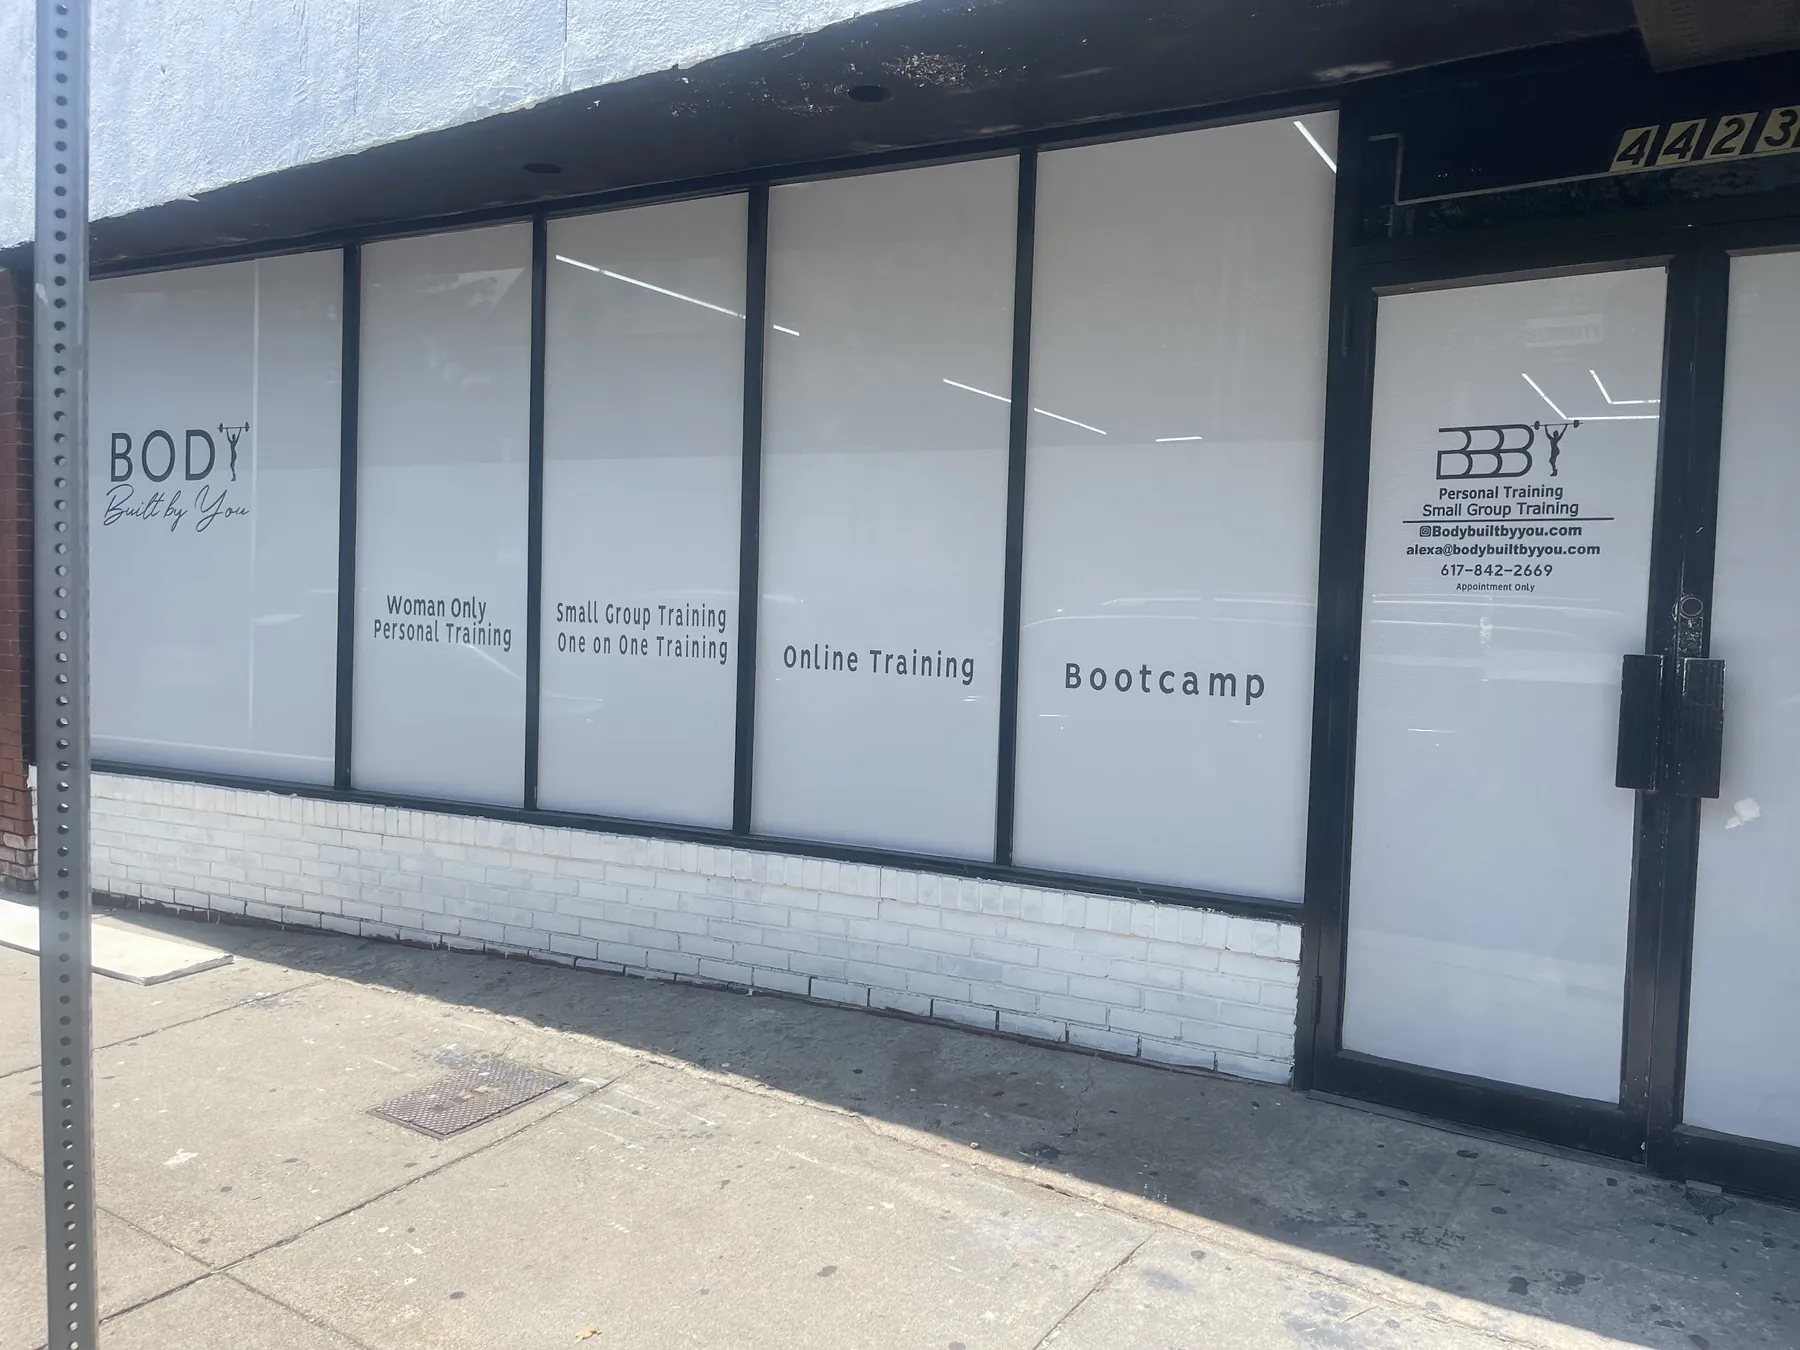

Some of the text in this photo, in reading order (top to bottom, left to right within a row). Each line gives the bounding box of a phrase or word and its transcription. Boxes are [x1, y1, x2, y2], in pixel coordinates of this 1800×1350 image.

[1616, 109, 1799, 166] 4423
[103, 483, 250, 533] Built by You
[1439, 484, 1564, 501] Personal Training
[1422, 501, 1579, 518] Small Group Training
[1432, 524, 1583, 540] Bodybuiltbyyou.com
[1406, 543, 1601, 558] alexa@bodybuiltbyyou.com
[1440, 563, 1553, 577] 617-842-2669
[1455, 582, 1536, 593] Appointment Only
[386, 594, 487, 625] Woman Only
[556, 601, 727, 634] Small Group Training
[374, 618, 512, 653] Personal Training
[557, 632, 729, 666] One on One Training
[783, 643, 975, 686] Online Training
[1065, 662, 1265, 706] Bootcamp
